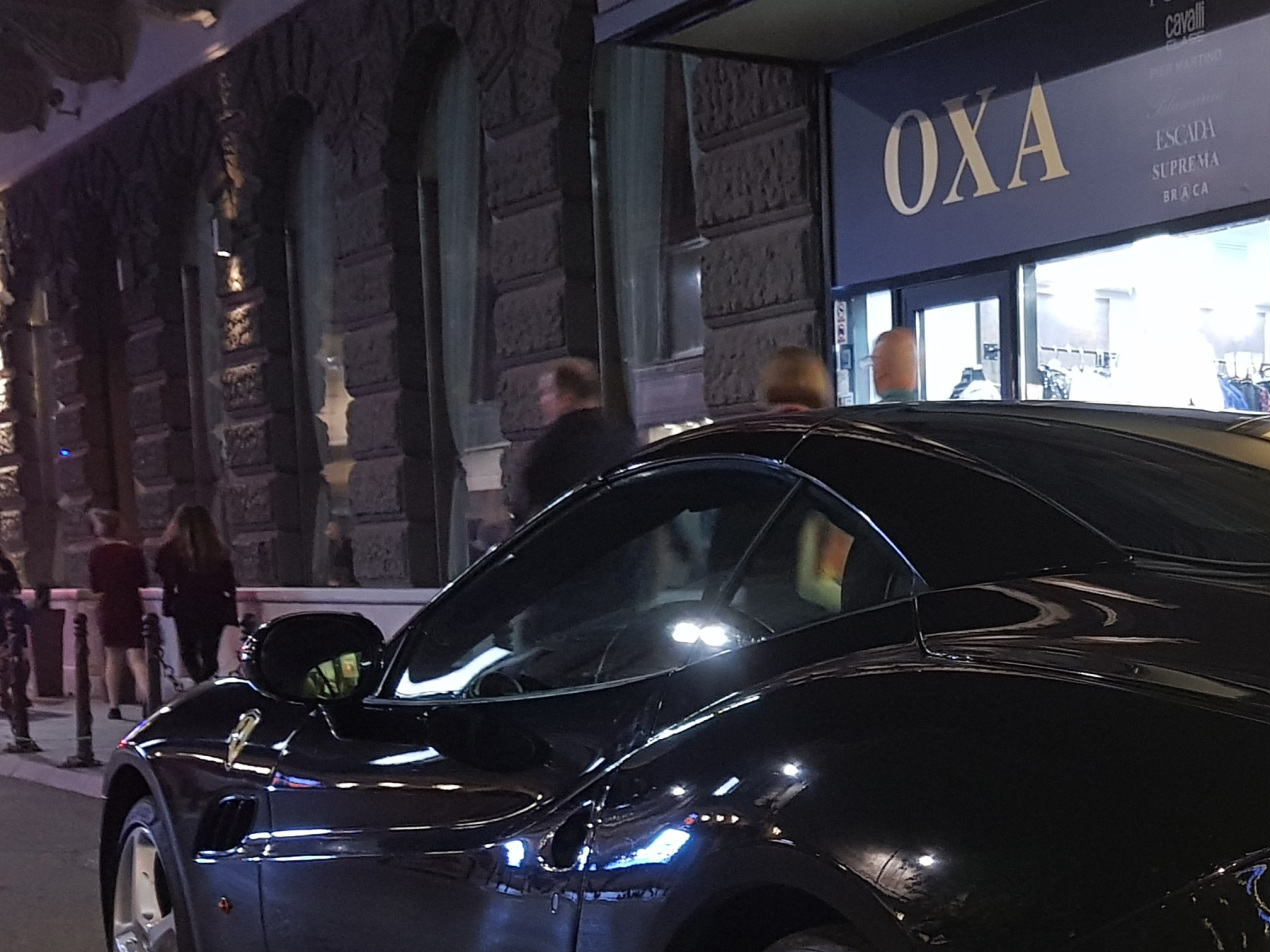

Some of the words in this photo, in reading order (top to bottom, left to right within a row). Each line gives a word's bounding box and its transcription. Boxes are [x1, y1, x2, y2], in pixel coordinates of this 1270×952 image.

[1165, 1, 1205, 38] cavalli
[884, 72, 1070, 216] OXA
[1156, 117, 1216, 151] ESCADA
[1152, 151, 1219, 180] SUPREMA
[1163, 182, 1208, 203] BRACA
